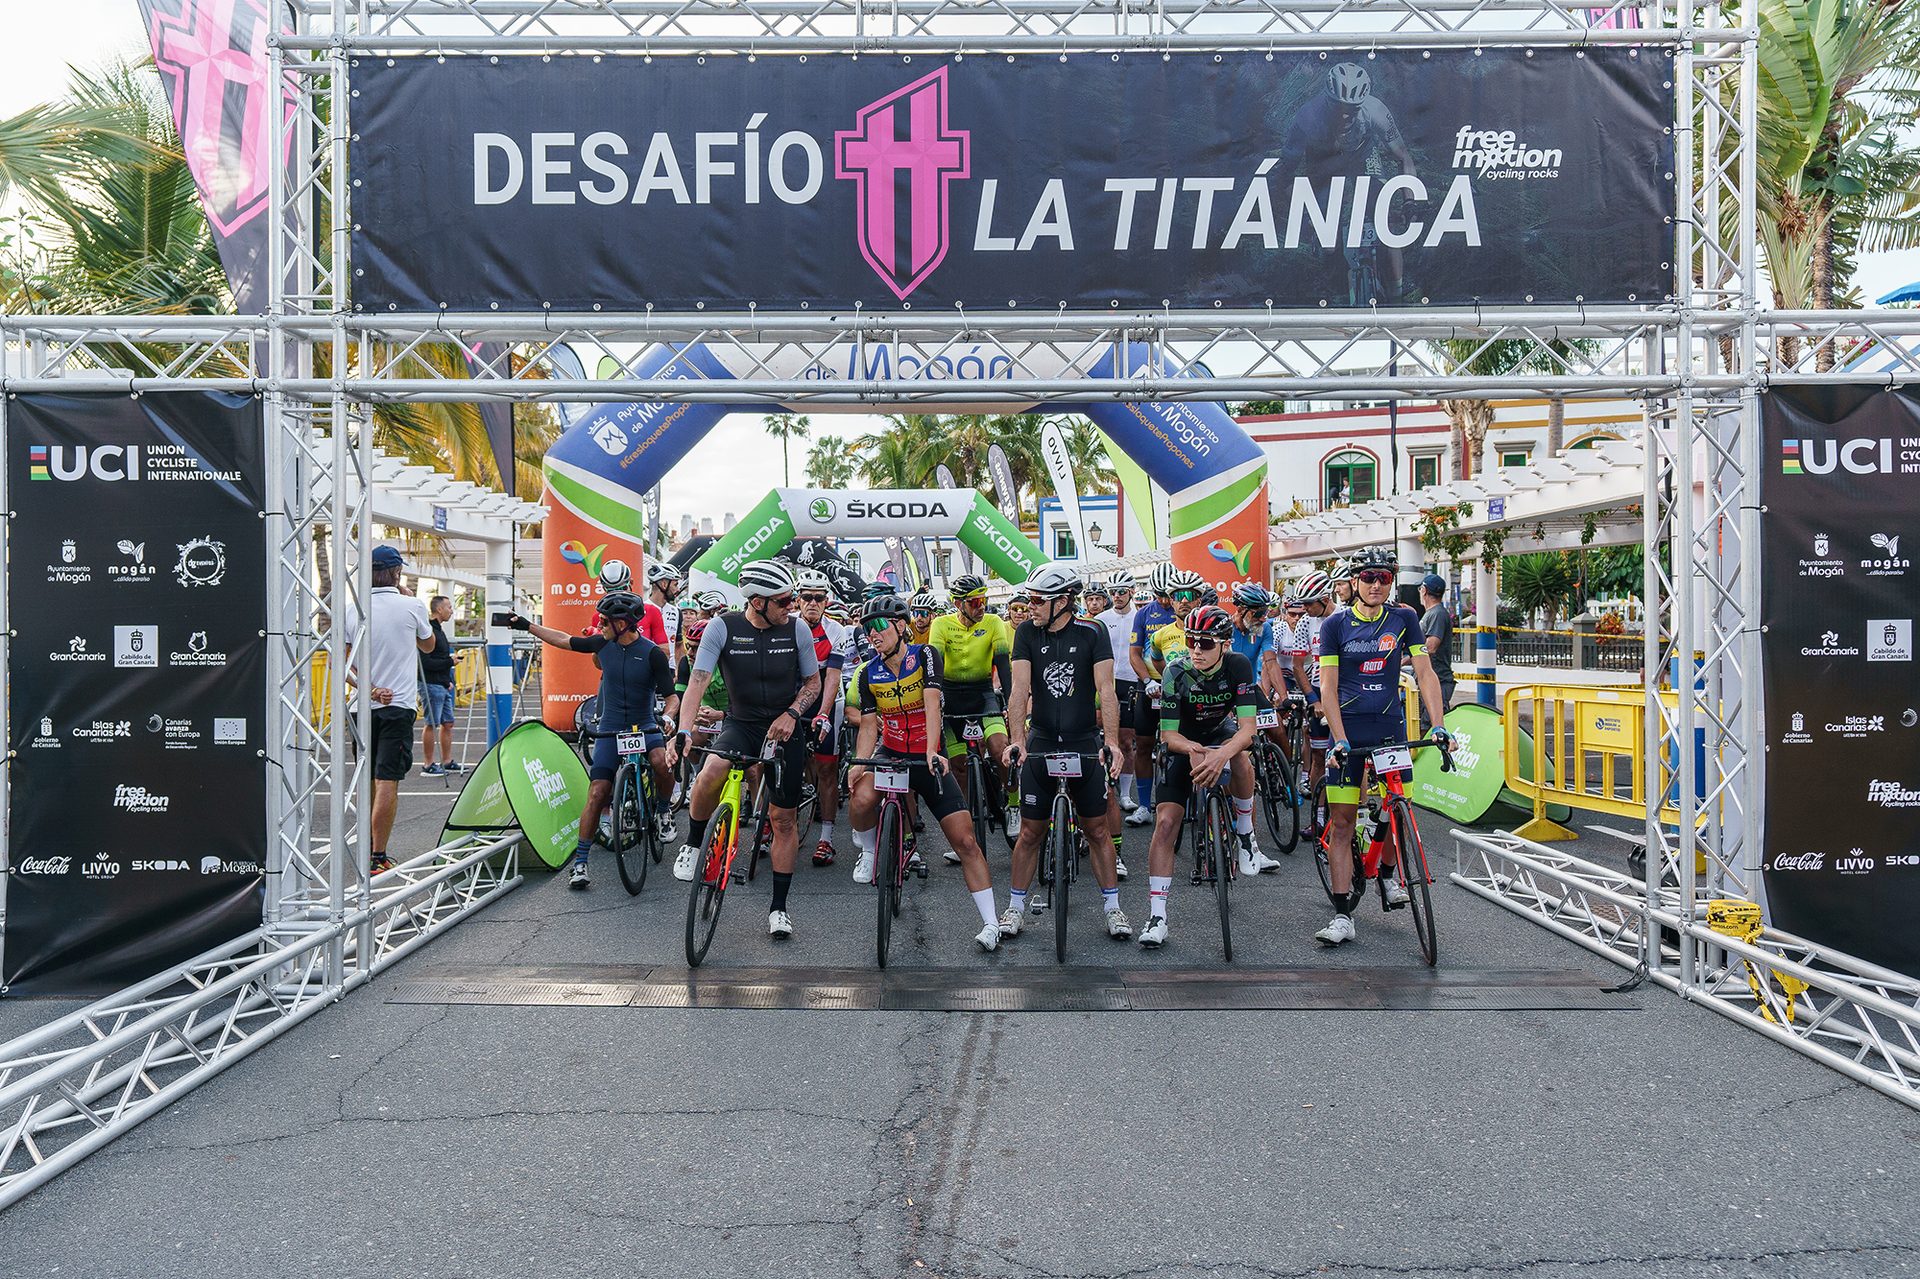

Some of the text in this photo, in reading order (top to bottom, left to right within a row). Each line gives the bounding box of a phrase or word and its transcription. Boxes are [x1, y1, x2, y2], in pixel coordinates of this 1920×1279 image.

[1456, 125, 1516, 149] free
[473, 112, 824, 205] DESAFÍO
[1486, 168, 1559, 180] cycling rocks
[972, 158, 1482, 251] LA TITÁNICA
[1160, 405, 1211, 457] Mogán
[147, 445, 185, 455] UNION
[1802, 438, 1893, 475] UCI
[51, 445, 139, 482] UCI
[147, 458, 198, 468] CYCLISTE
[147, 471, 242, 481] INTERNATIONALE
[847, 498, 949, 518] ŠKODA
[721, 516, 785, 575] ŠKODA
[973, 515, 1034, 575] ŠKODA
[47, 565, 91, 573] Ayuntamiento
[1799, 559, 1843, 567] Ayuntamiento
[1860, 557, 1910, 569] mogán
[108, 563, 156, 576] mogán
[1808, 566, 1844, 578] Mogán
[56, 572, 91, 584] Mogán
[92, 721, 114, 729] Islas
[165, 718, 192, 726] Canarias
[1257, 716, 1274, 725] 178
[1845, 716, 1867, 724] Islas
[72, 728, 114, 737] Canarias
[967, 728, 979, 736] 26
[1825, 723, 1867, 731] Canarias
[622, 739, 641, 749] 160
[1059, 761, 1068, 772] 3
[1388, 755, 1398, 766] 2
[888, 776, 894, 787] 1
[1868, 779, 1900, 792] free
[115, 784, 146, 797] free
[82, 862, 120, 875] LIVVO
[1835, 858, 1874, 870] LIVVO
